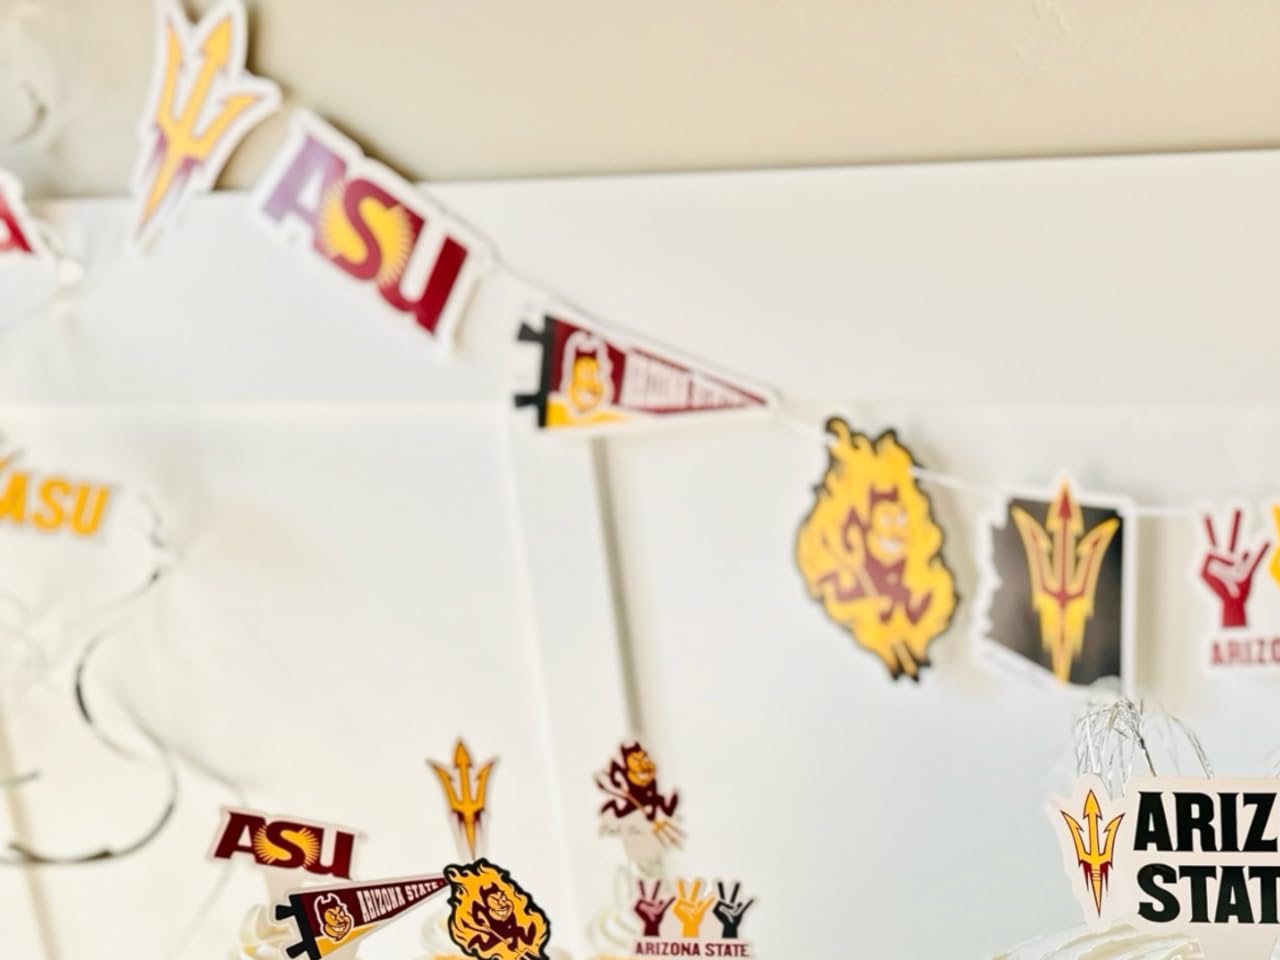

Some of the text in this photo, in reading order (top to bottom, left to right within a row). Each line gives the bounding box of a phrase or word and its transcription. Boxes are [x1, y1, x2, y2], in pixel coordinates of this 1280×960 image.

[262, 134, 467, 336] ASU
[0, 472, 111, 537] ASU
[214, 811, 355, 880] ASU
[356, 881, 439, 923] ARIZONA STATE
[636, 942, 749, 957] ARIZONA STATE
